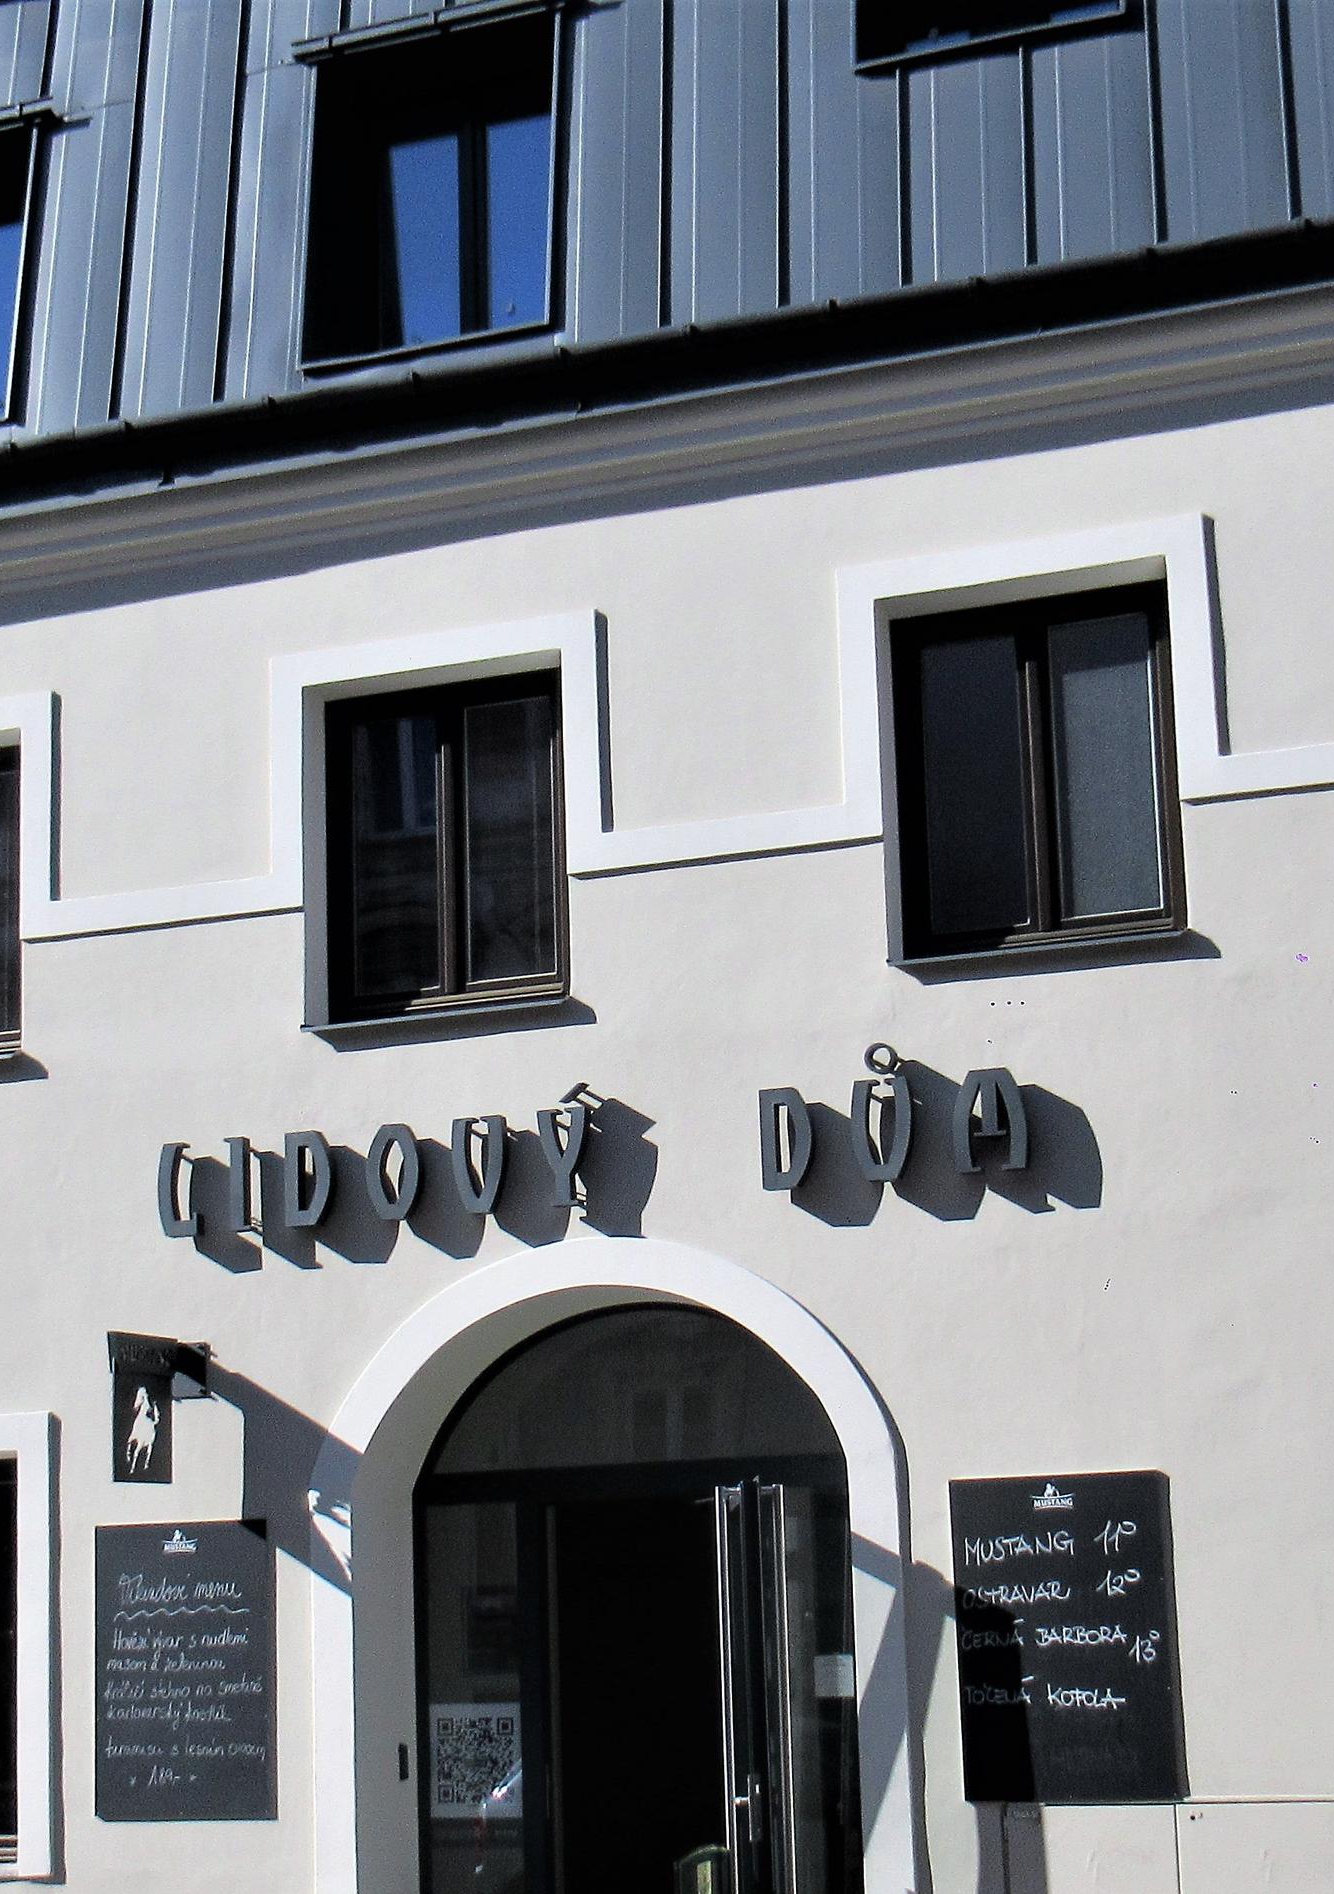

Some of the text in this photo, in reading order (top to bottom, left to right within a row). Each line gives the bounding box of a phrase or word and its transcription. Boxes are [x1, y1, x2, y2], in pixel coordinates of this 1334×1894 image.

[157, 1041, 1026, 1238] LIDOVÝ DŮM
[1033, 1497, 1073, 1508] MUSTANG
[964, 1531, 1075, 1566] MUSTANG
[193, 1581, 243, 1600] menu
[962, 1582, 1071, 1609] OSTRAVAR
[1036, 1624, 1127, 1647] BARBORA
